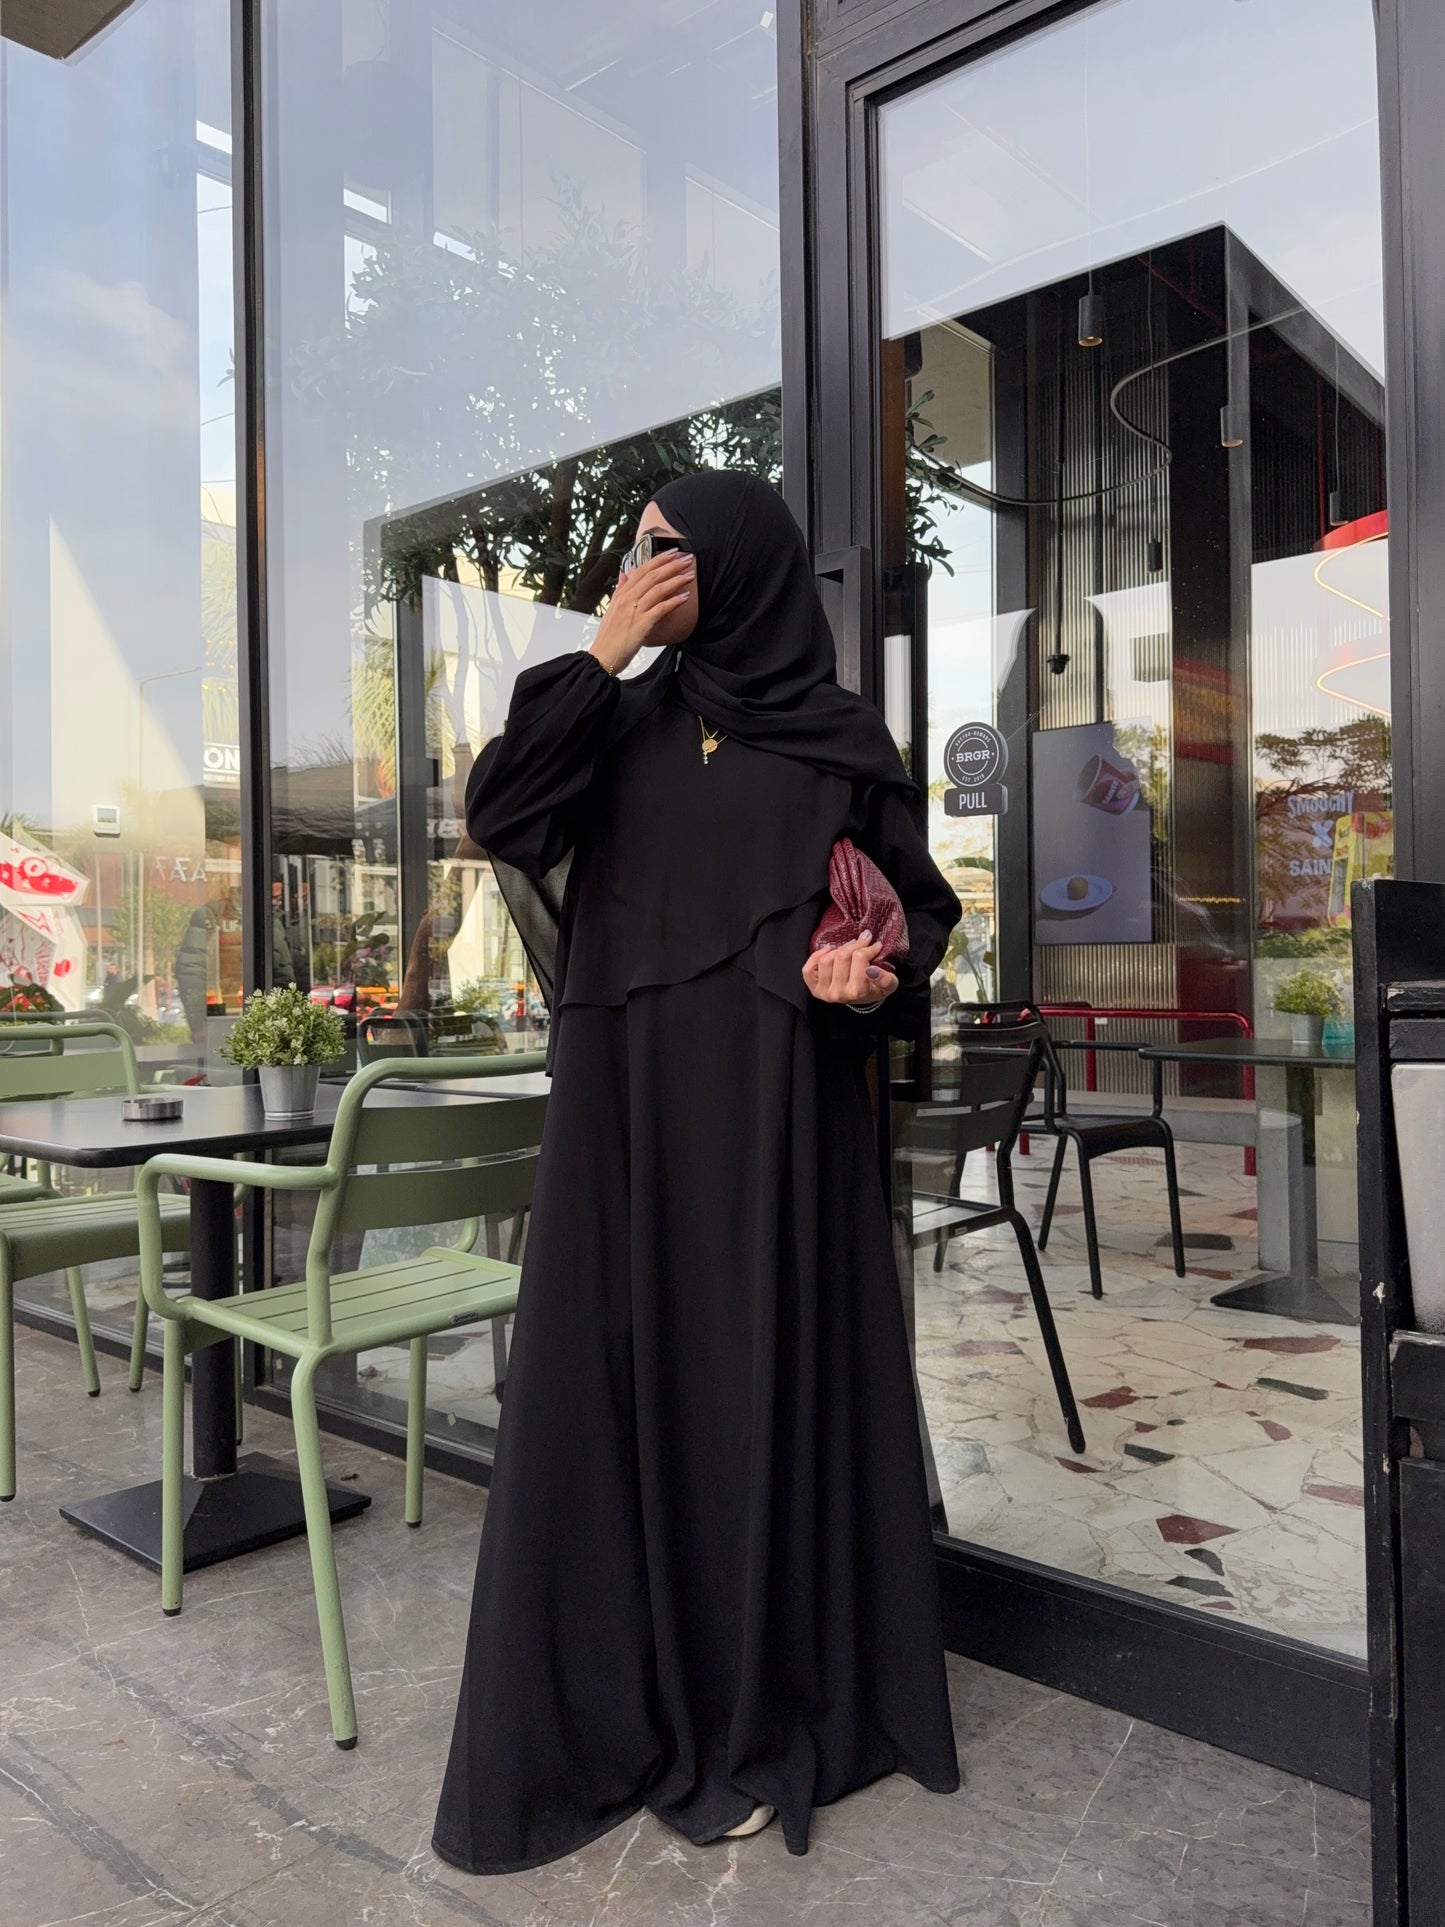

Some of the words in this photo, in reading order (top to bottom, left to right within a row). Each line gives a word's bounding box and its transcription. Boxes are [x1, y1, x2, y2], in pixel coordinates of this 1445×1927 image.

[956, 750, 990, 763] BRGR
[959, 792, 987, 810] PULL
[1288, 789, 1354, 818] SMOOCHY
[1289, 859, 1331, 876] SAIN
